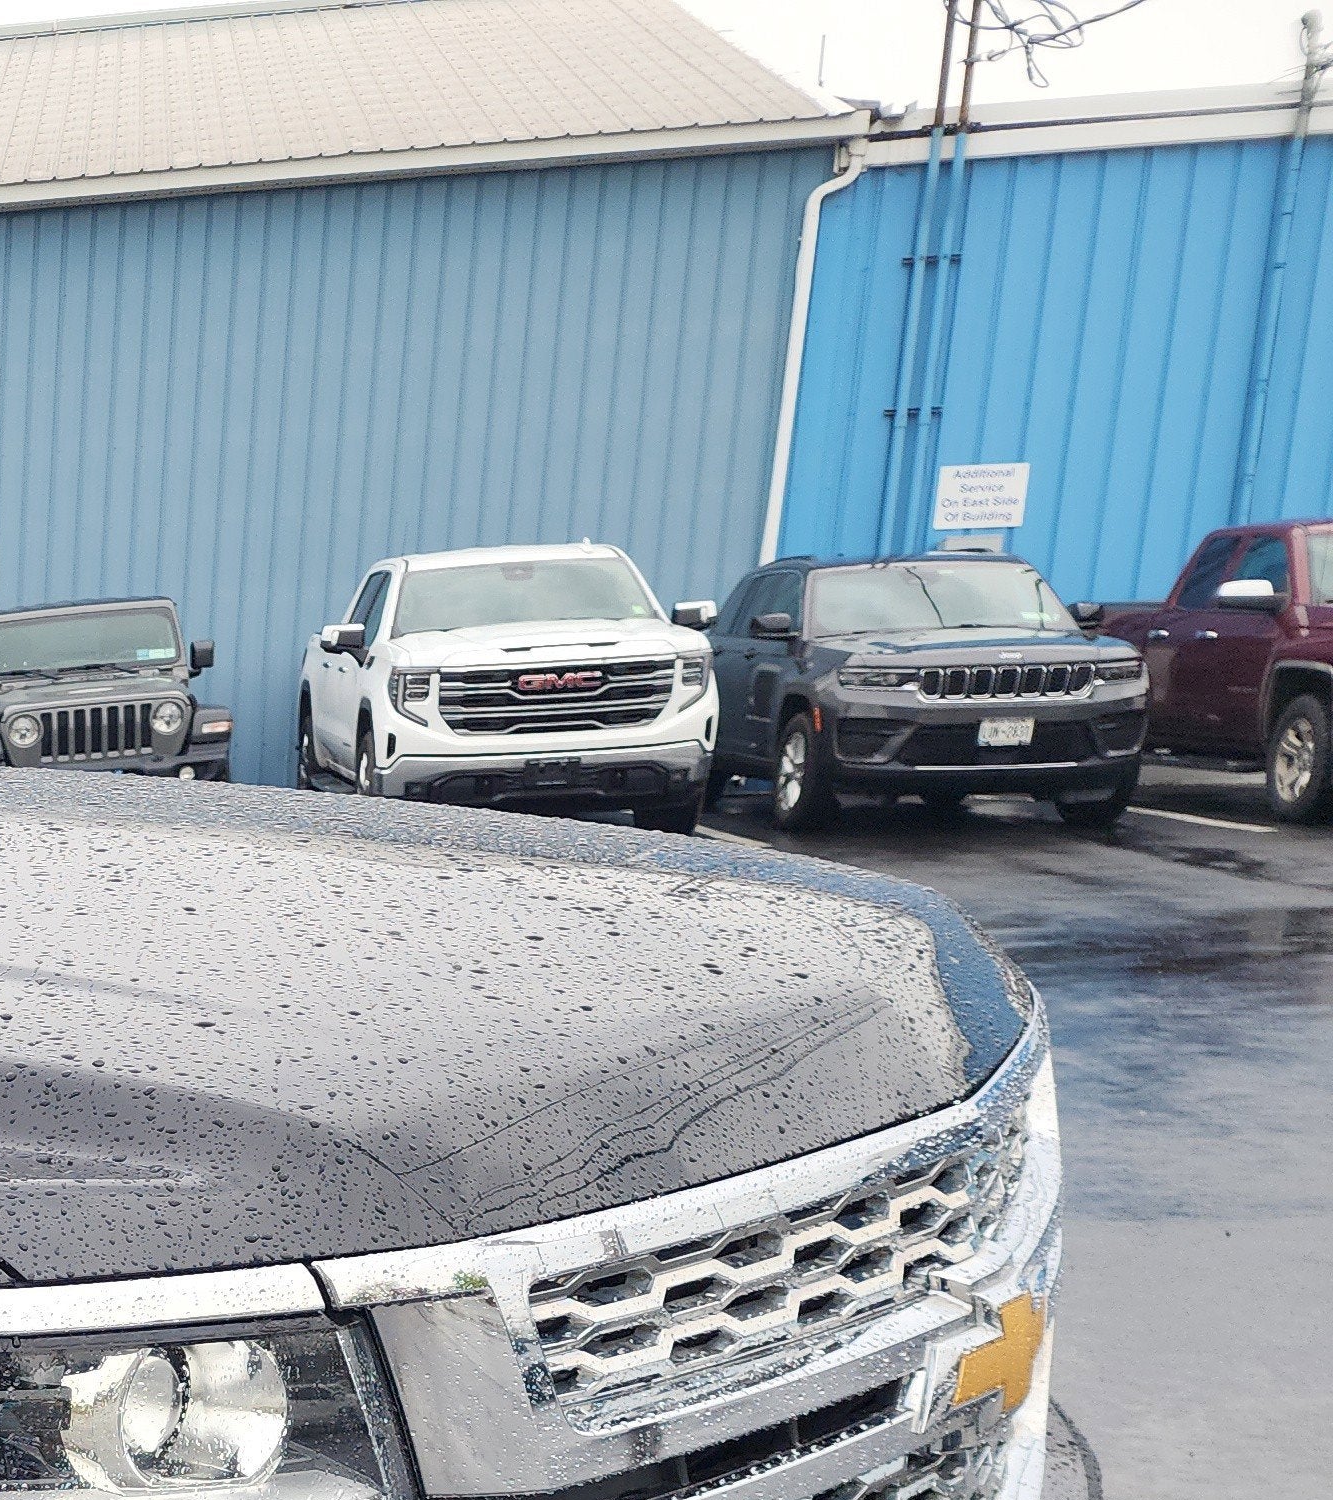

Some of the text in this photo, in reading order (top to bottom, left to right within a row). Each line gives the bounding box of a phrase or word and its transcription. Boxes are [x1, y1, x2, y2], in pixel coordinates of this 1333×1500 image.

[953, 467, 1016, 479] Additional
[959, 483, 1006, 494] Service
[941, 496, 1019, 508] On East Side
[962, 511, 1013, 523] Building
[517, 670, 603, 691] GMC
